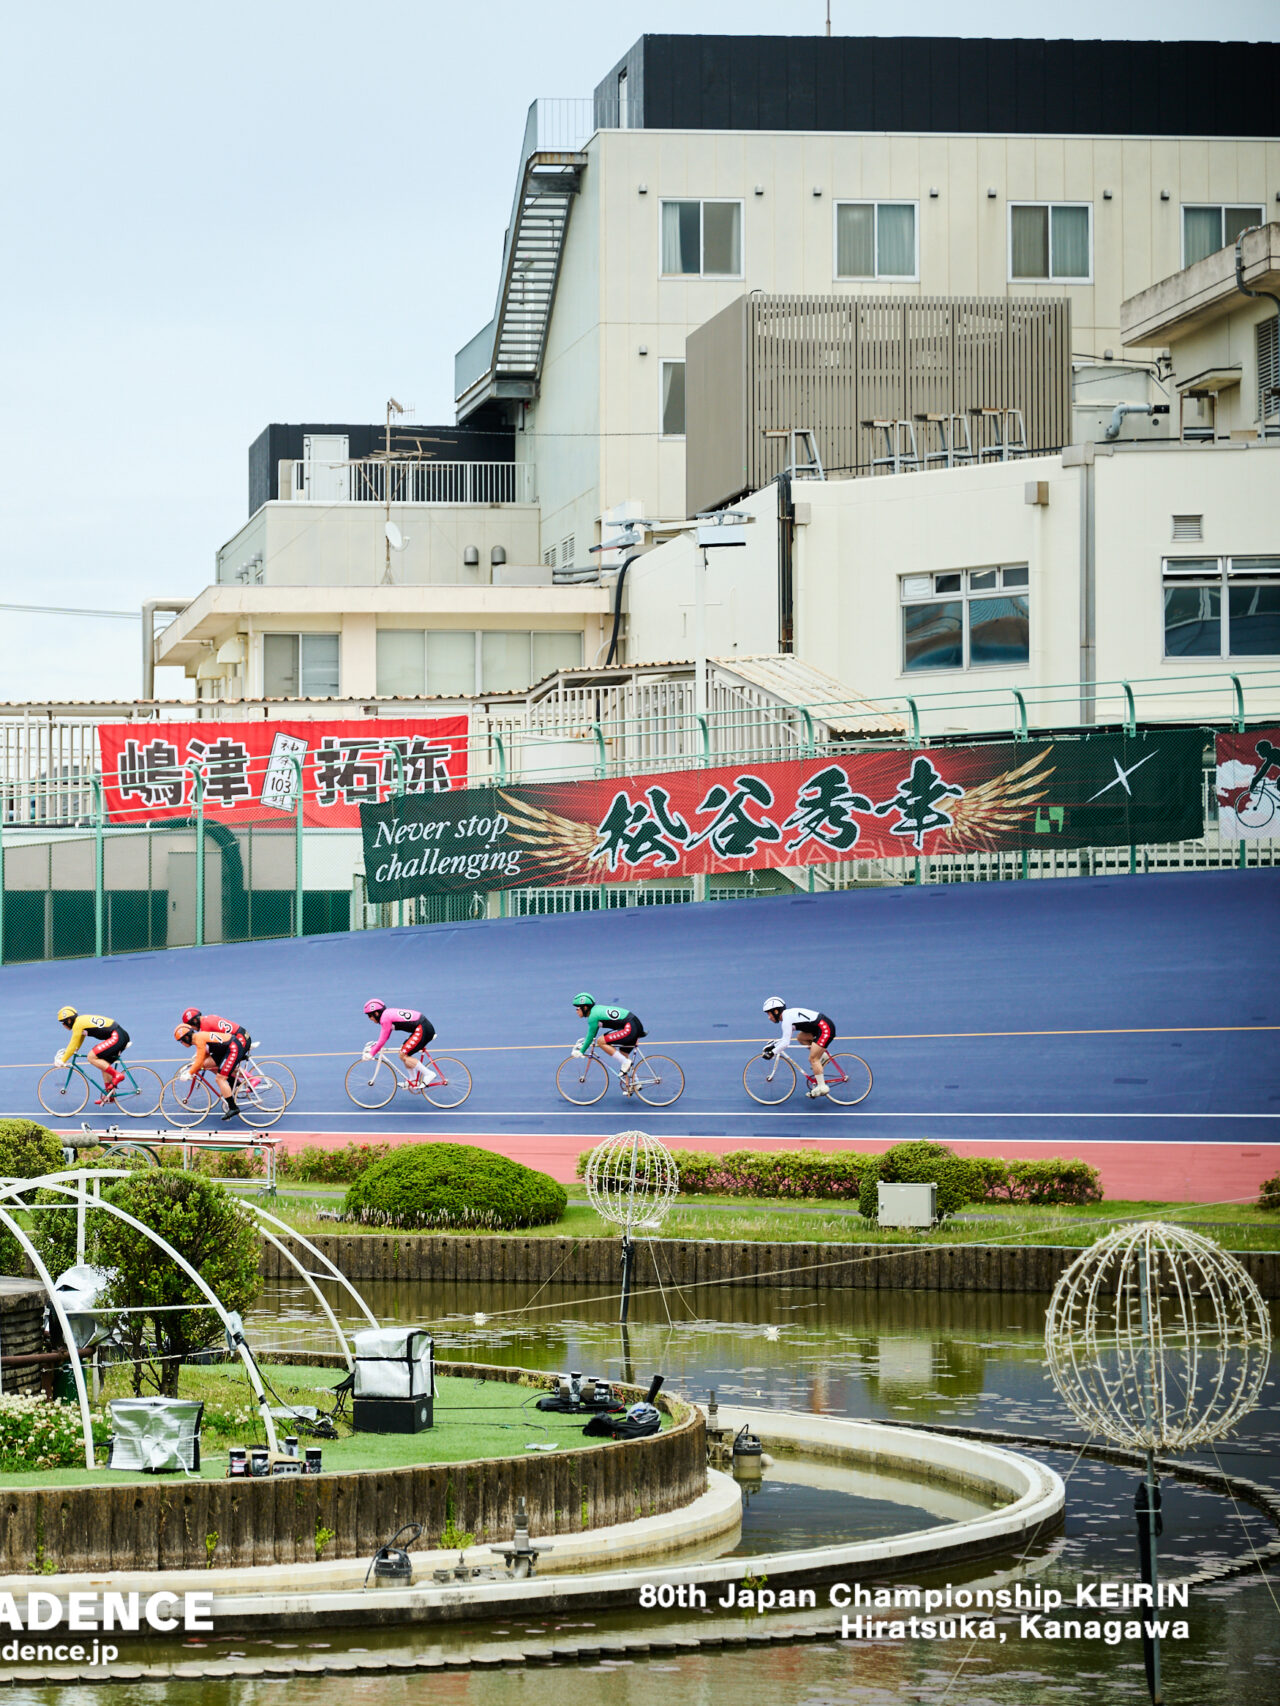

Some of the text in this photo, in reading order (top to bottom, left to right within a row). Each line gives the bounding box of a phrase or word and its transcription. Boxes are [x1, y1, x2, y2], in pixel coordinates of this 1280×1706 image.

[372, 814, 509, 848] Never stop
[375, 844, 523, 883] challenging
[398, 1010, 412, 1020] 8
[606, 1008, 620, 1020] 6
[91, 1016, 106, 1029] 5
[218, 1019, 233, 1035] 3
